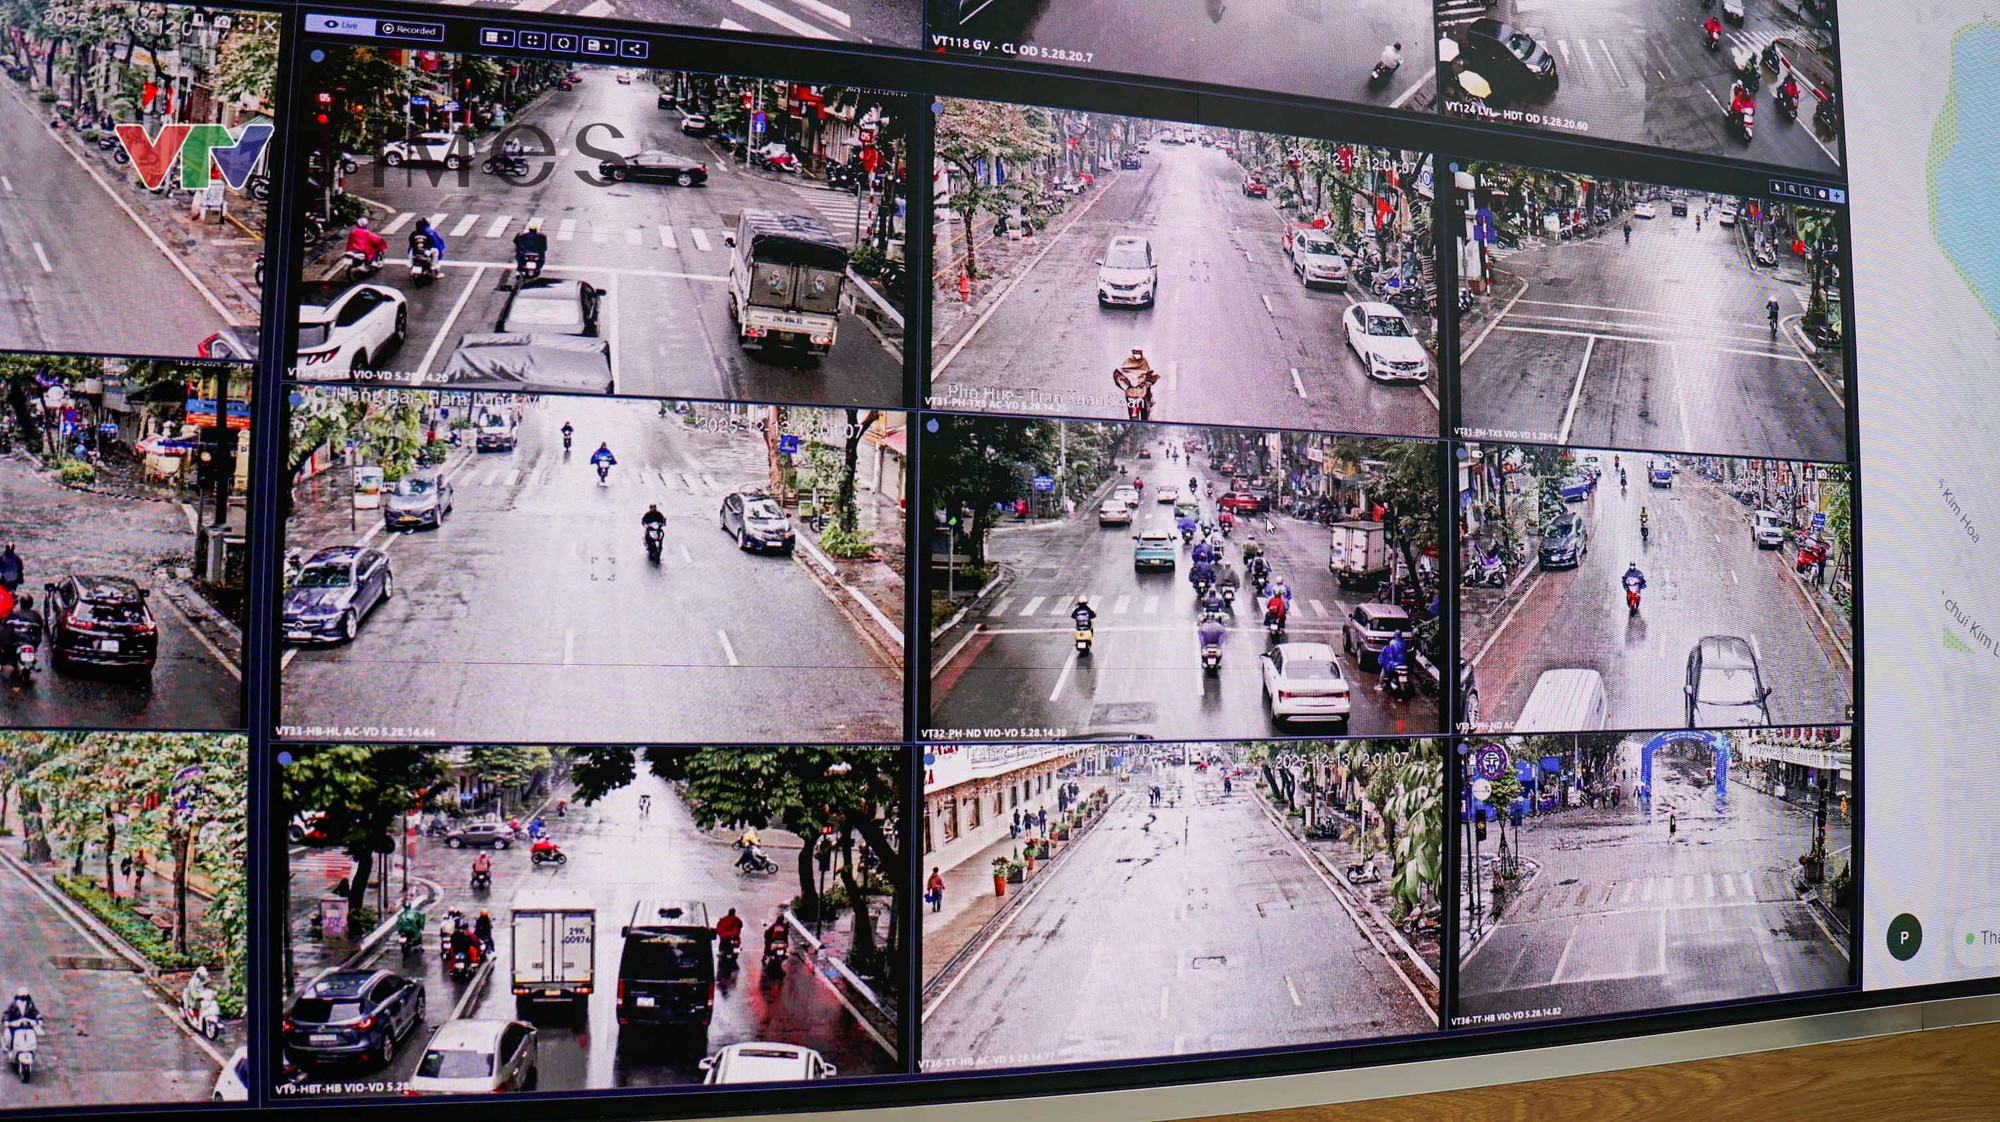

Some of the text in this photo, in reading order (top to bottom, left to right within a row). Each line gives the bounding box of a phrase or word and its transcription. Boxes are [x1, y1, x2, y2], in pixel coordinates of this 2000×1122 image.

[341, 21, 358, 30] Live
[396, 25, 436, 36] Recorded
[932, 34, 970, 49] VT118
[973, 39, 991, 51] GV
[1002, 42, 1017, 54] CL
[1019, 44, 1039, 57] OD
[1041, 47, 1094, 63] 5.28.20.7
[1445, 101, 1476, 114] VT124
[1503, 110, 1524, 121] HDT
[1525, 112, 1541, 124] OD
[1542, 115, 1589, 132] 5.28.20.60
[353, 370, 393, 381] VIO-VD
[1503, 430, 1531, 439] VIO-VD
[1942, 488, 1981, 544] Kim Hoa
[1969, 621, 1993, 649] Kim
[275, 726, 341, 737] VT33-HB-HL
[343, 726, 379, 737] AC-VD
[921, 728, 1068, 739] VT32-PH-ND VIO-VD 5.28.14.39
[1275, 751, 1409, 769] 2025-12-13 12:01:07
[569, 927, 585, 936] 29K
[564, 936, 591, 944] 00976
[1900, 931, 1910, 945] P
[1451, 1014, 1496, 1026] VT36-TT-HB
[1497, 1010, 1525, 1021] VIO-VD
[275, 1083, 342, 1095] VT9-HBT-HB
[344, 1082, 385, 1093] VIO-VD
